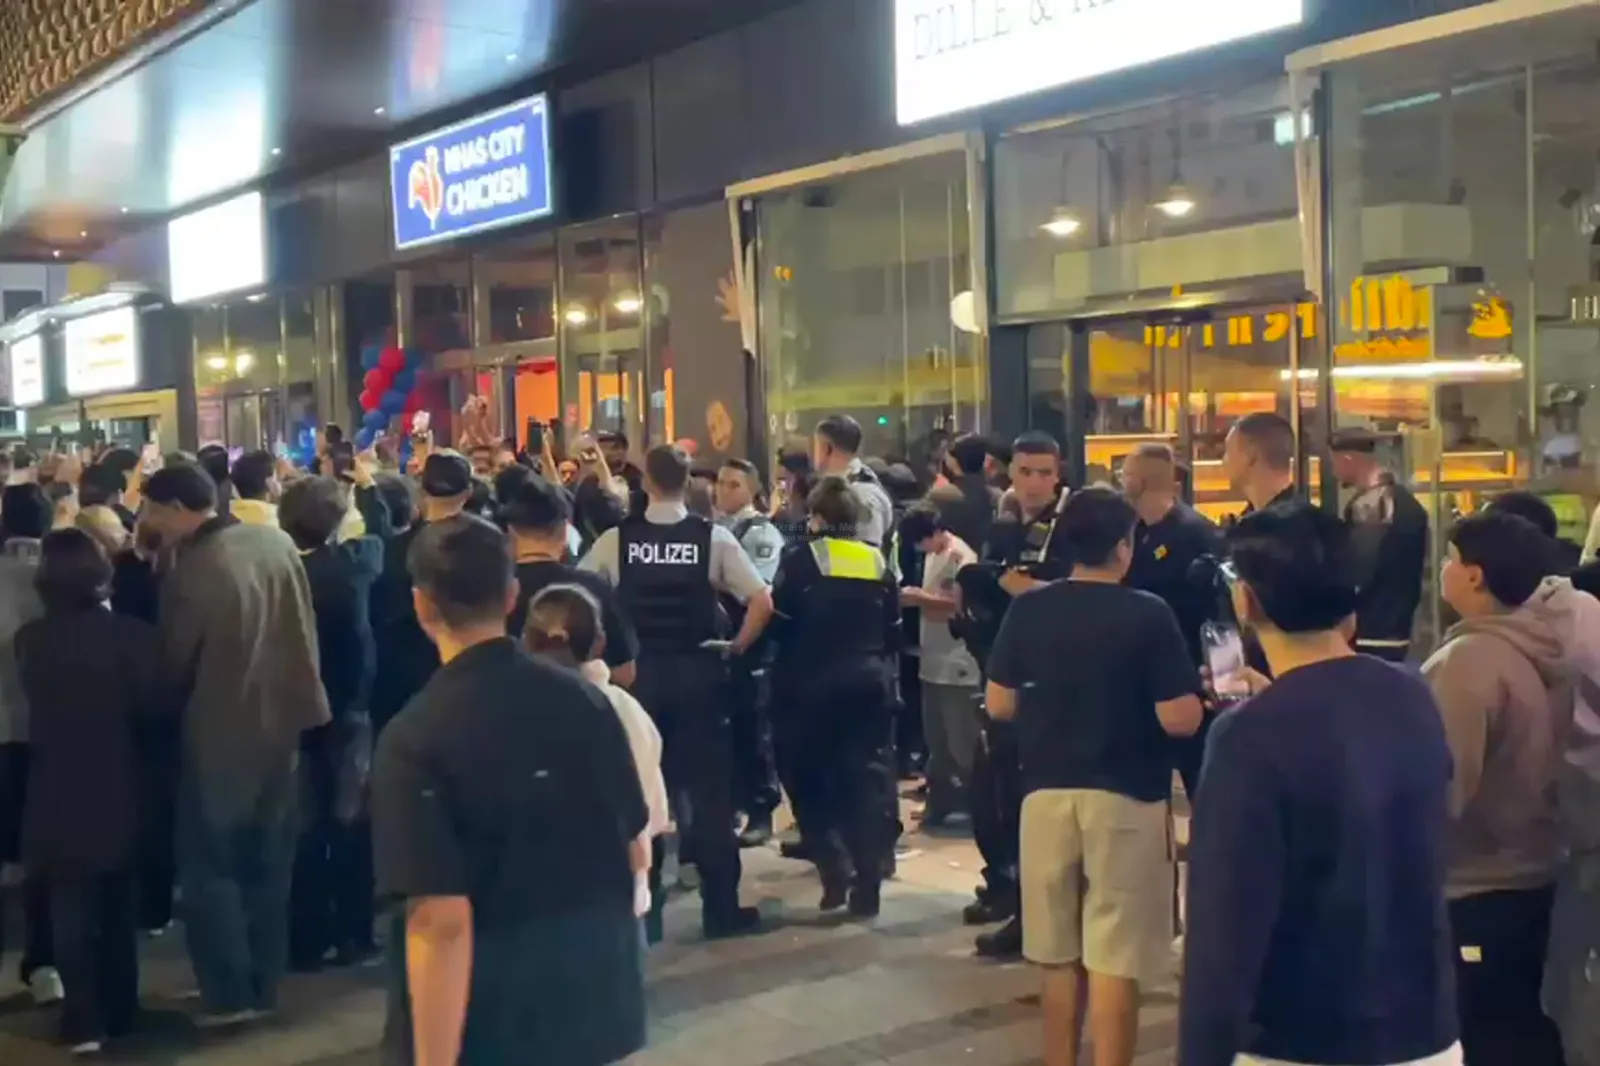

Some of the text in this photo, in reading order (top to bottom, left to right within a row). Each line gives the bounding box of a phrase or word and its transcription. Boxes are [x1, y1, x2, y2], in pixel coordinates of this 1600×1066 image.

[913, 0, 1011, 60] DILLE
[488, 123, 526, 161] CITY
[446, 163, 529, 215] CHICKEN
[628, 542, 699, 564] POLIZEI
